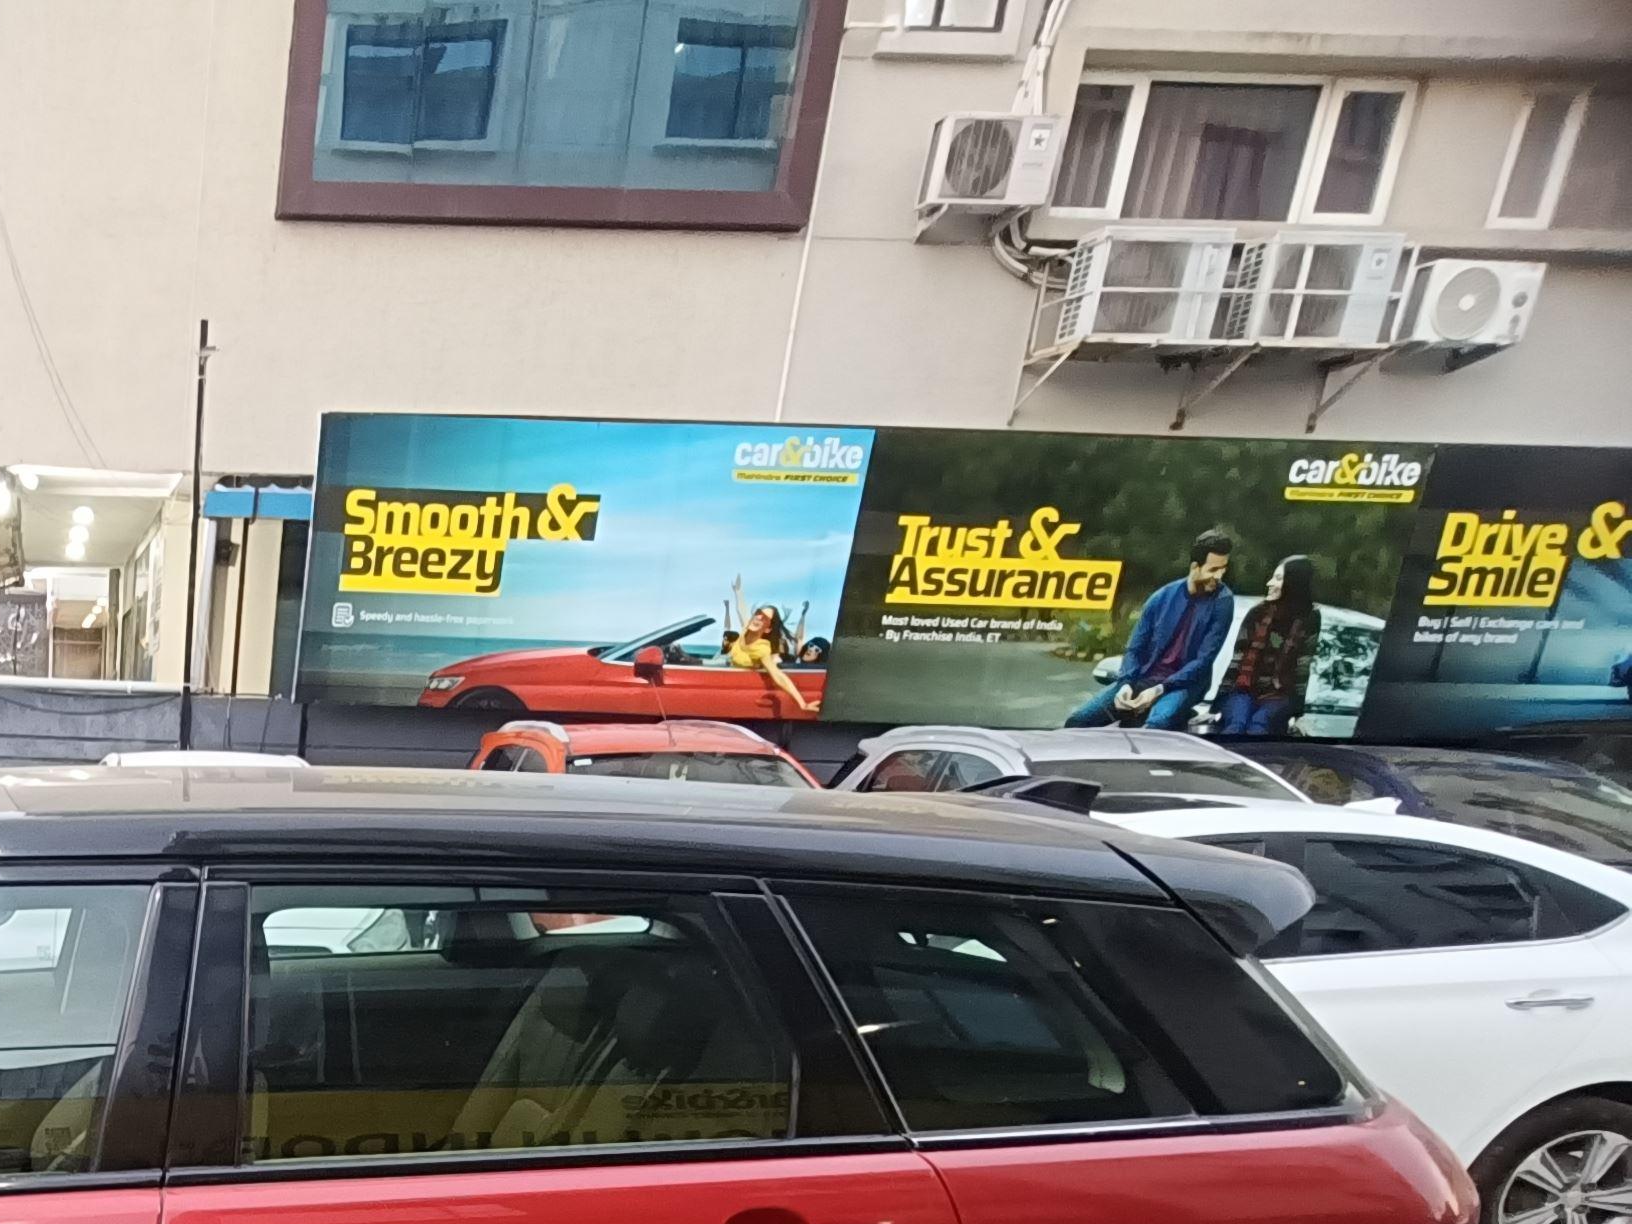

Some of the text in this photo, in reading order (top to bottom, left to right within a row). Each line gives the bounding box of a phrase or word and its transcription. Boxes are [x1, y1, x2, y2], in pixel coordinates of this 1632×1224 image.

[734, 435, 864, 469] car&bike
[1288, 453, 1422, 486] car&bike
[344, 483, 599, 541] Smooth &
[898, 506, 1081, 560] Trust &
[1436, 501, 1632, 559] Drive &
[340, 534, 505, 593] Breezy
[887, 557, 1113, 601] Assurance
[1426, 555, 1556, 598] Smile
[882, 615, 1063, 631] Most loved Used Car brand of India
[885, 630, 900, 642] By
[902, 629, 953, 641] Franchise
